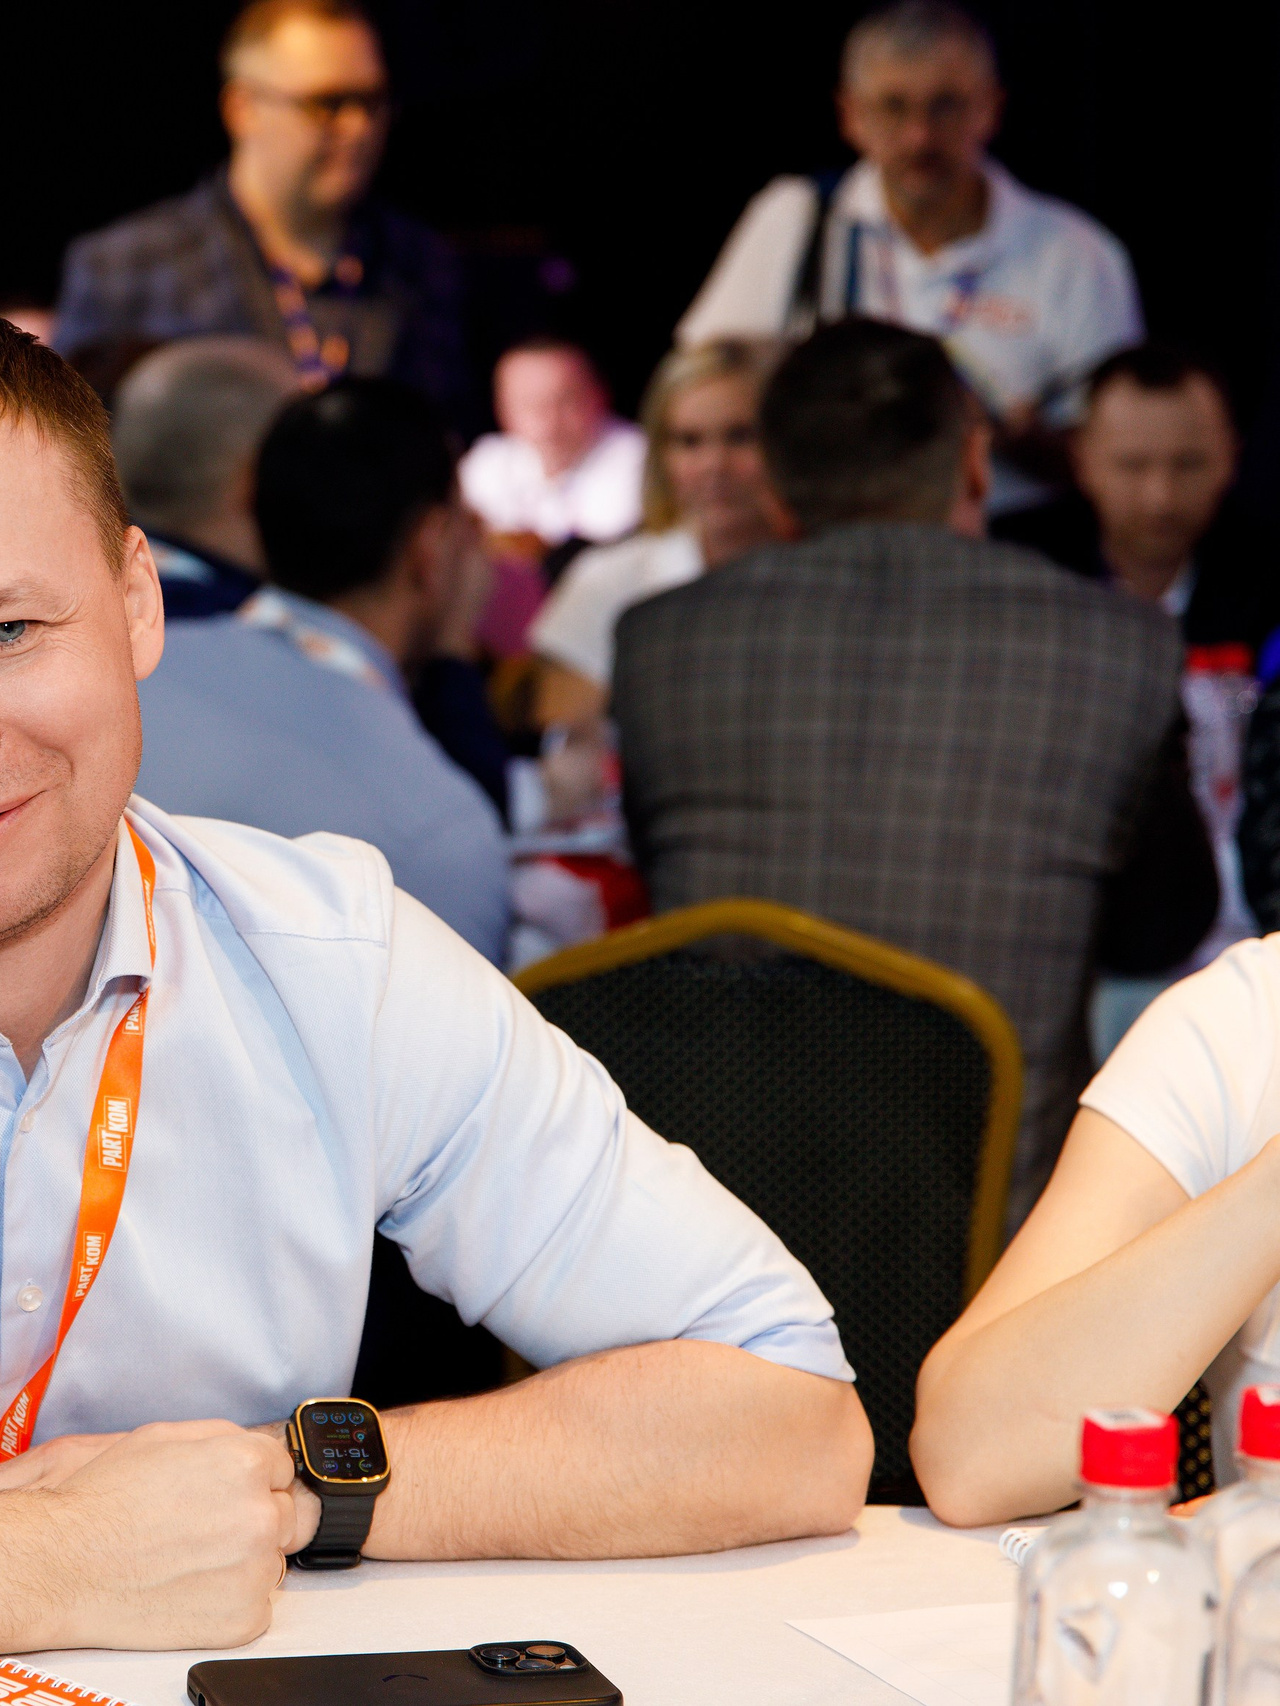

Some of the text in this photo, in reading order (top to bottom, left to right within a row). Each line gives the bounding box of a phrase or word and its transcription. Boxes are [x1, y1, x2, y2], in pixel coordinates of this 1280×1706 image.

[102, 1099, 128, 1167] PART KOM
[75, 1235, 102, 1298] PART KOM
[0, 1391, 30, 1457] PART KOM
[322, 1448, 370, 1458] 15:15
